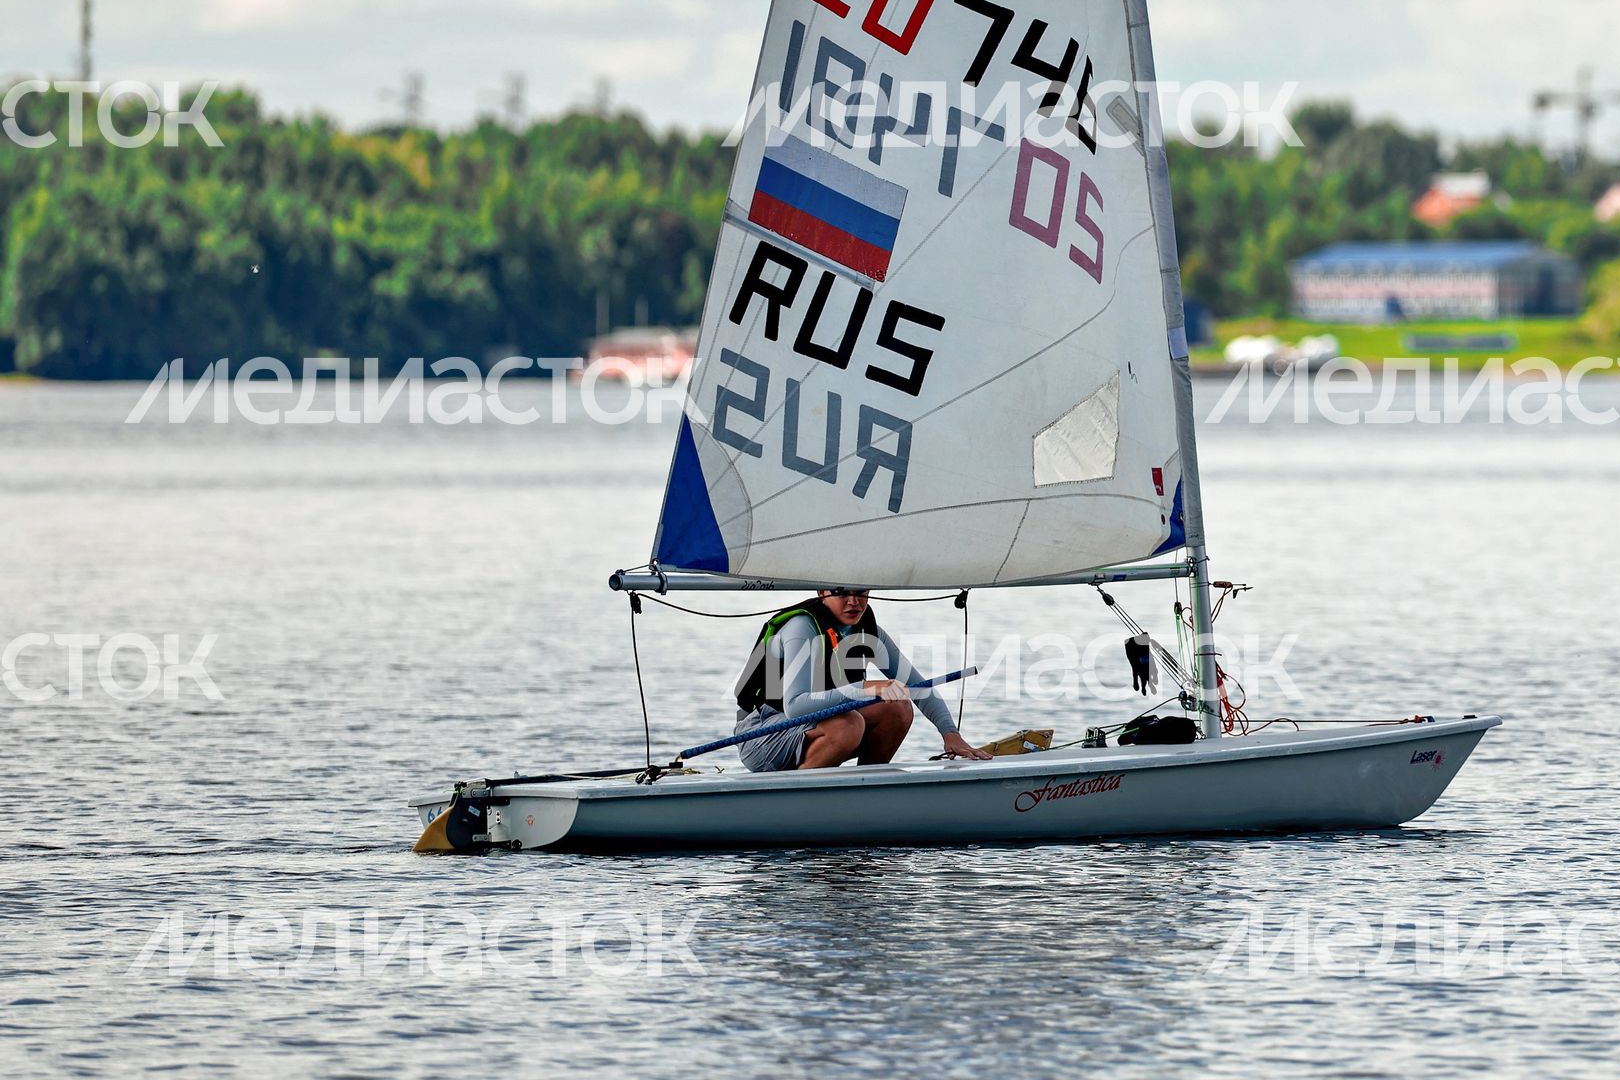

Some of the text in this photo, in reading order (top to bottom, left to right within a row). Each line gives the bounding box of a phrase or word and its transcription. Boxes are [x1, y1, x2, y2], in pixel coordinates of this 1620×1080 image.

[729, 240, 945, 396] RUS
[1410, 750, 1437, 764] Laser
[1015, 776, 1125, 812] Fantastica
